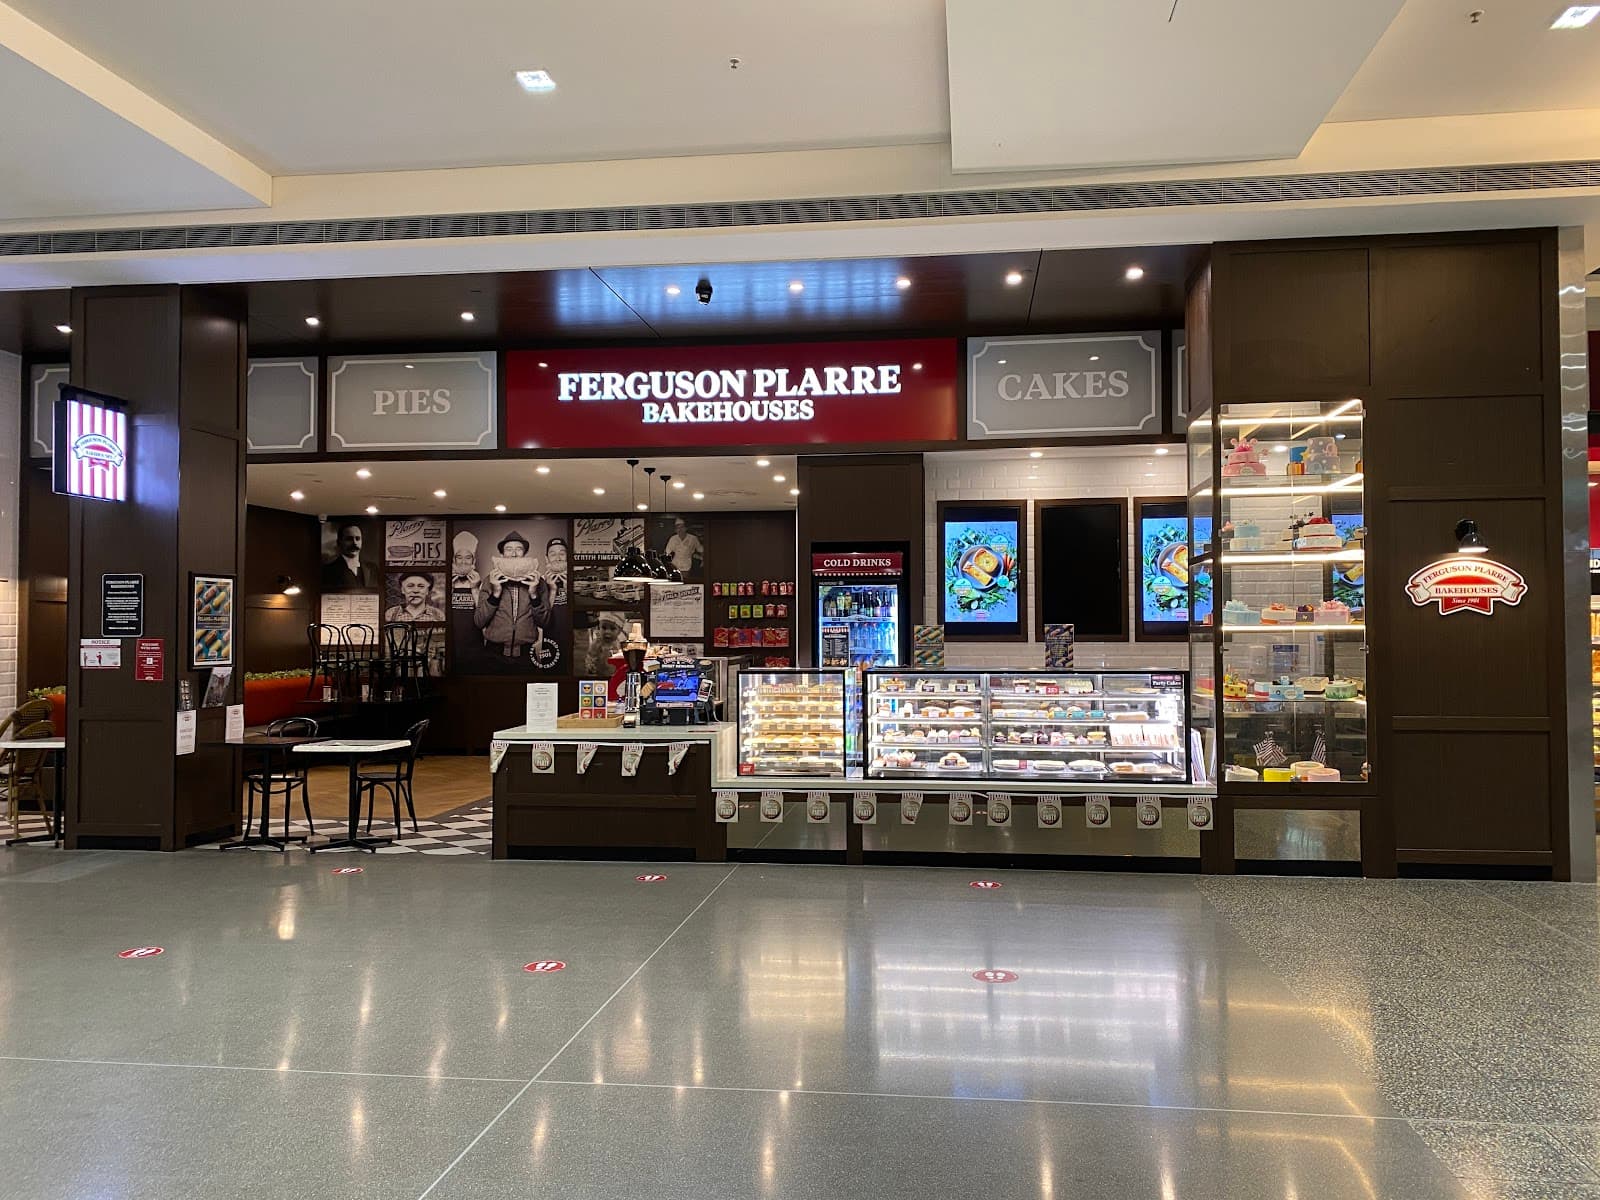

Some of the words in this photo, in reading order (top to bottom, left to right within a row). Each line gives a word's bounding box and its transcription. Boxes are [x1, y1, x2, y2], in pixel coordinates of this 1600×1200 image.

[557, 370, 747, 401] FERGUSON
[752, 365, 902, 397] PLARRE
[997, 370, 1129, 401] CAKES
[372, 388, 451, 416] PIES
[641, 399, 815, 424] BAKEHOUSES
[413, 542, 442, 559] PIES
[823, 559, 851, 567] COLD
[852, 558, 892, 567] DRINKS
[1423, 564, 1472, 583] FERGUSON
[1474, 565, 1510, 583] PLARRE
[1435, 586, 1499, 595] BAKEHOUSES
